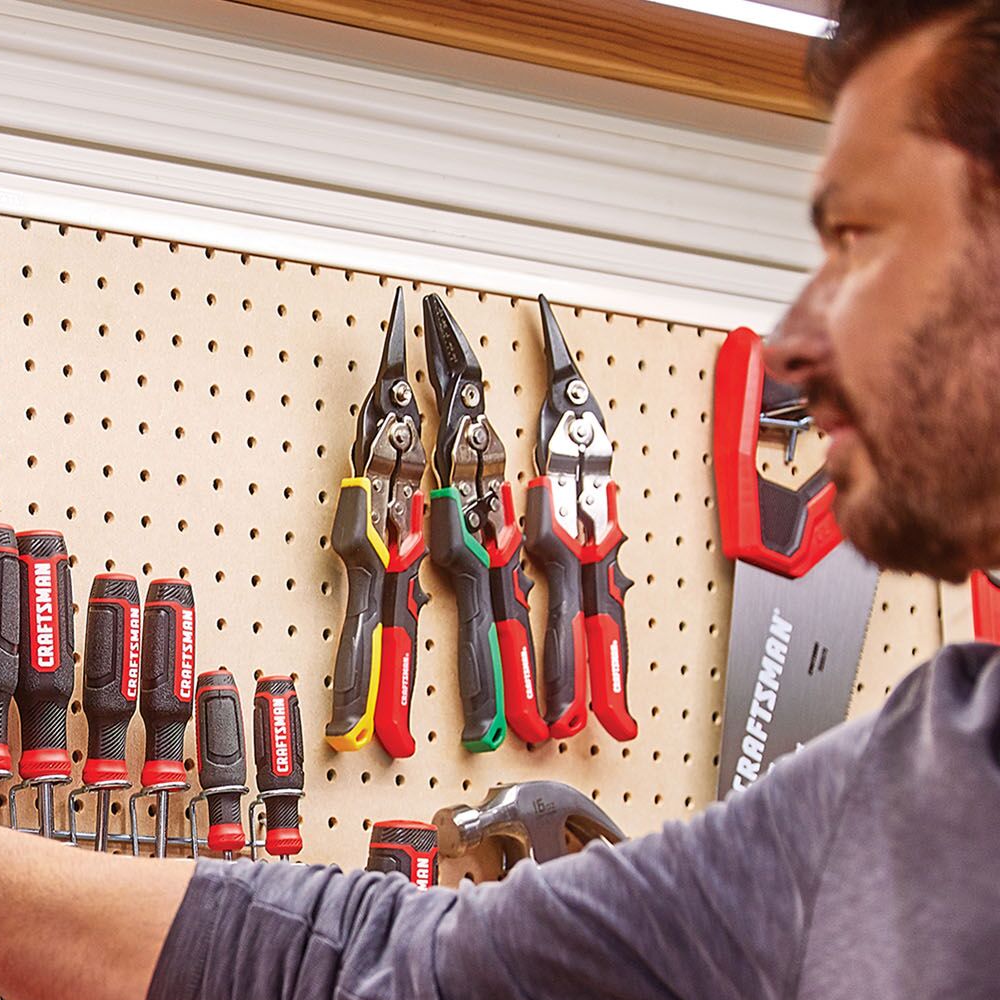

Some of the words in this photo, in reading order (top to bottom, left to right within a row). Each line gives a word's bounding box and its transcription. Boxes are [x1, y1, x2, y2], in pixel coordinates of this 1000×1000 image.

[37, 562, 54, 668] CRAFTSMAN
[126, 607, 140, 699] CRAFTSMAN
[179, 609, 193, 699] CRAFTSMAN
[273, 698, 287, 773] CRAFTSMAN
[732, 618, 793, 792] CRAFTSMAN
